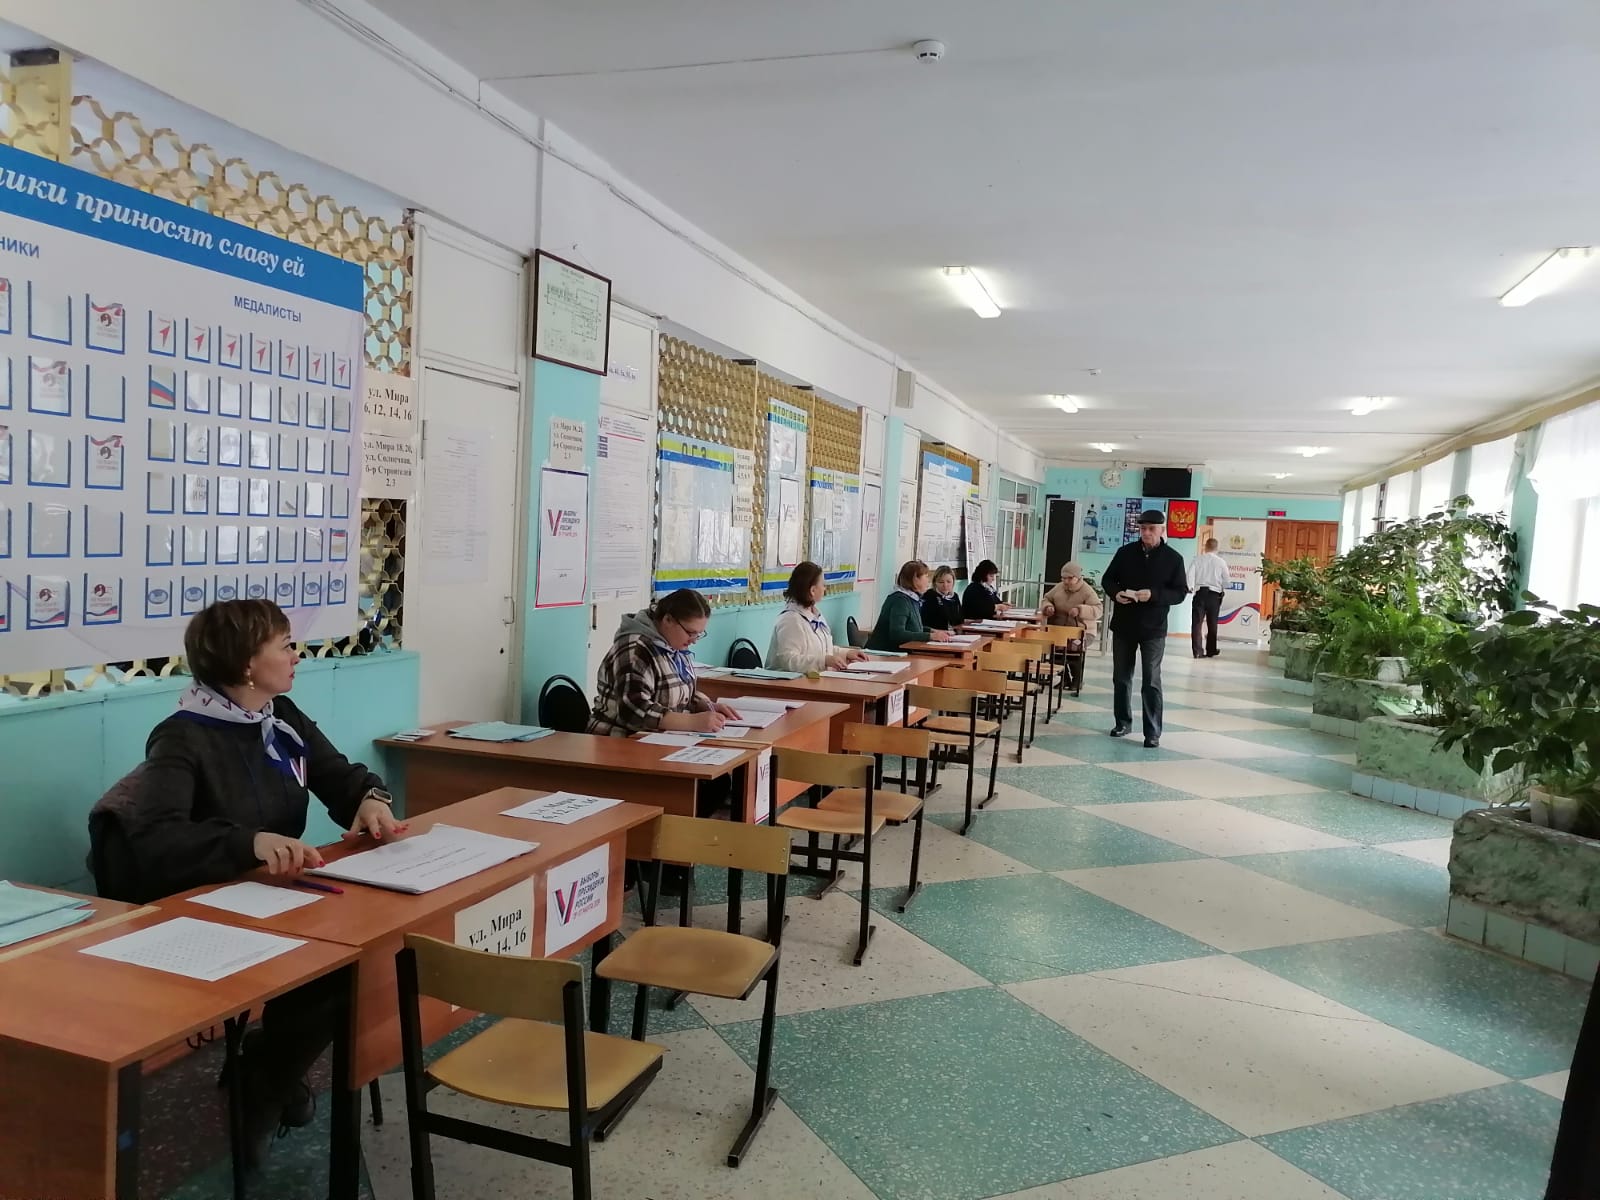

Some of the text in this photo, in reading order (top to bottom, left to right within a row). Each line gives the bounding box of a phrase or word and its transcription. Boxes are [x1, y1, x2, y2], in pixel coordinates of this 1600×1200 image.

[76, 192, 213, 250] приносят
[219, 238, 279, 274] славу
[282, 256, 305, 278] ей
[234, 296, 301, 323] МЕДАЛИСТЫ
[368, 387, 409, 406] ул. Мира
[364, 402, 412, 421] 6, 12, 14, 16
[376, 441, 395, 452] Мира
[469, 909, 522, 947] ул. Мира
[515, 926, 527, 946] 16
